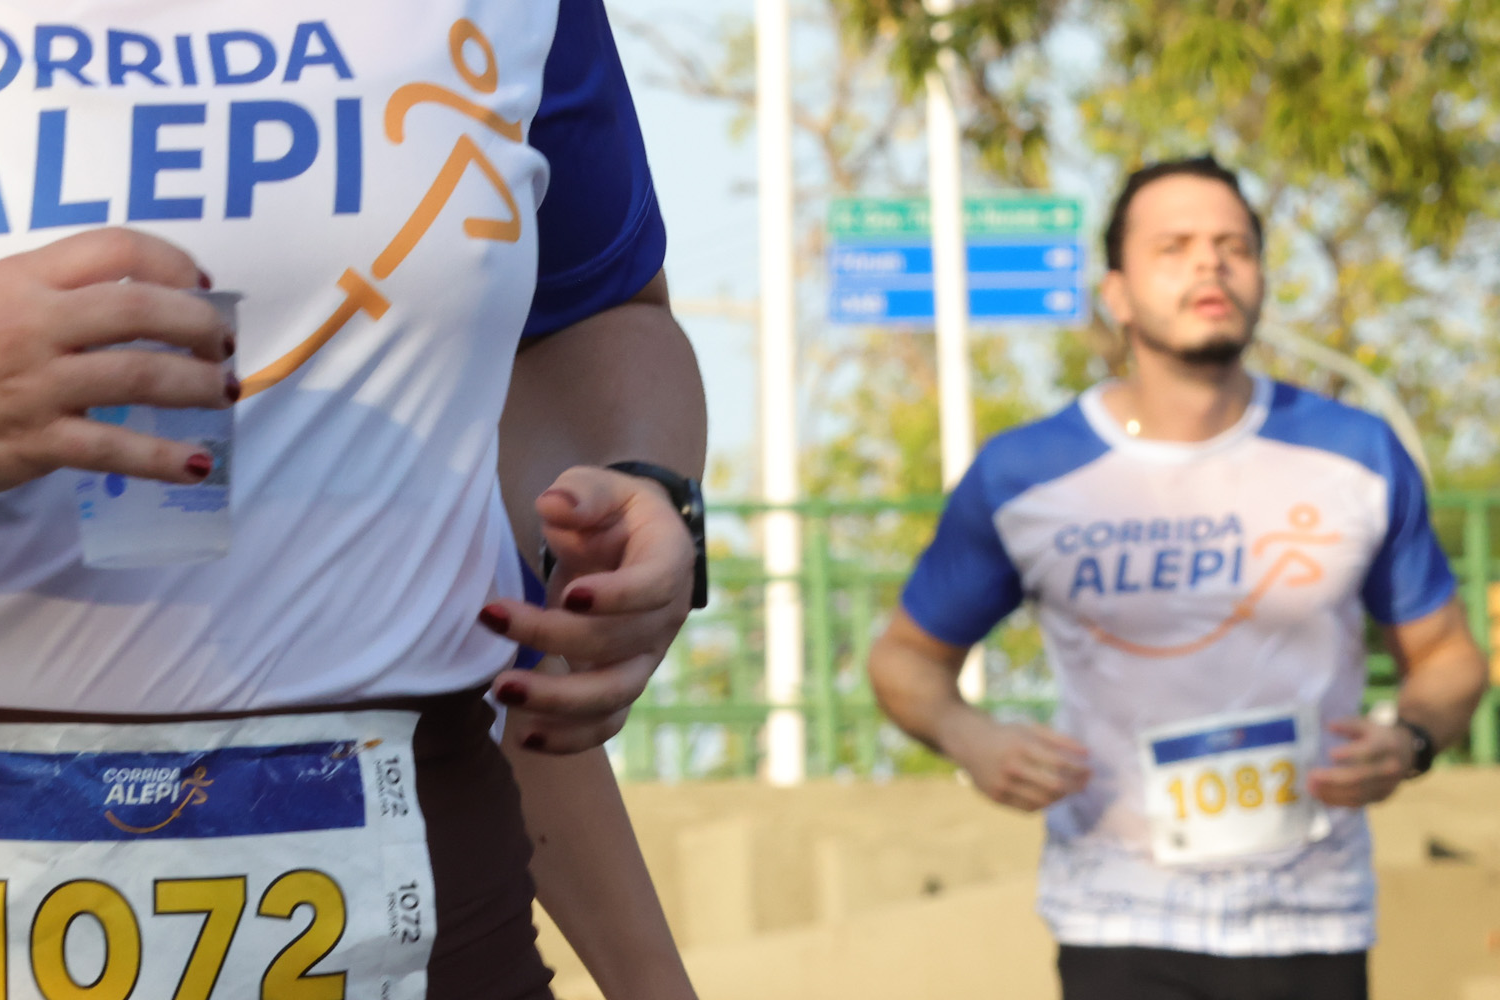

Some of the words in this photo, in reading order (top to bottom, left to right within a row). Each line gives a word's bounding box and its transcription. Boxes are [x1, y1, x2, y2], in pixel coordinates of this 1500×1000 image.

[1054, 512, 1242, 555] CORRIDA
[1070, 546, 1243, 599] ALEPI
[103, 781, 181, 805] ALEPI
[1167, 759, 1298, 821] 1082
[399, 880, 421, 945] 1072
